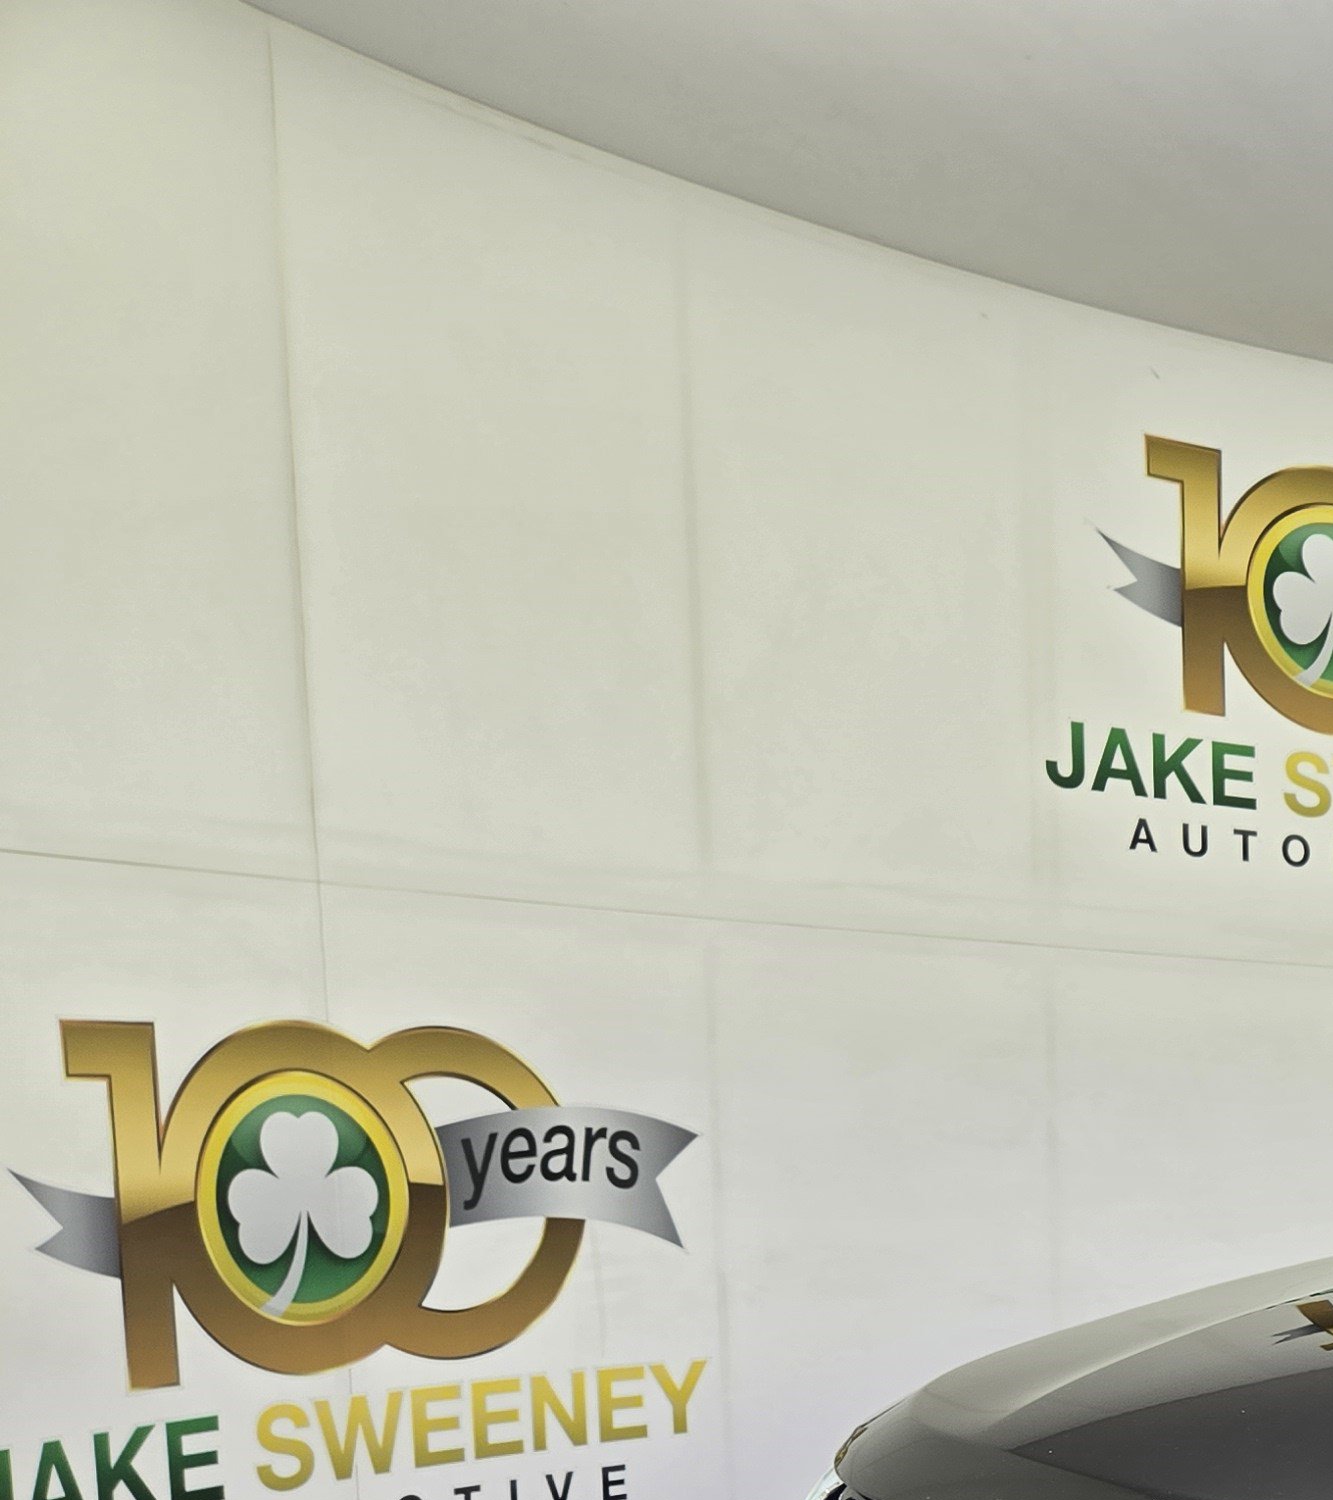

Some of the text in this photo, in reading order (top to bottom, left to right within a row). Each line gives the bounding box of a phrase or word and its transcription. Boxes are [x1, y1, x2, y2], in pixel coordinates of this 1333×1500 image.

[1045, 721, 1257, 810] JAKE
[59, 1019, 587, 1393] 100
[461, 1122, 642, 1211] years
[255, 1360, 708, 1492] SWEENEY
